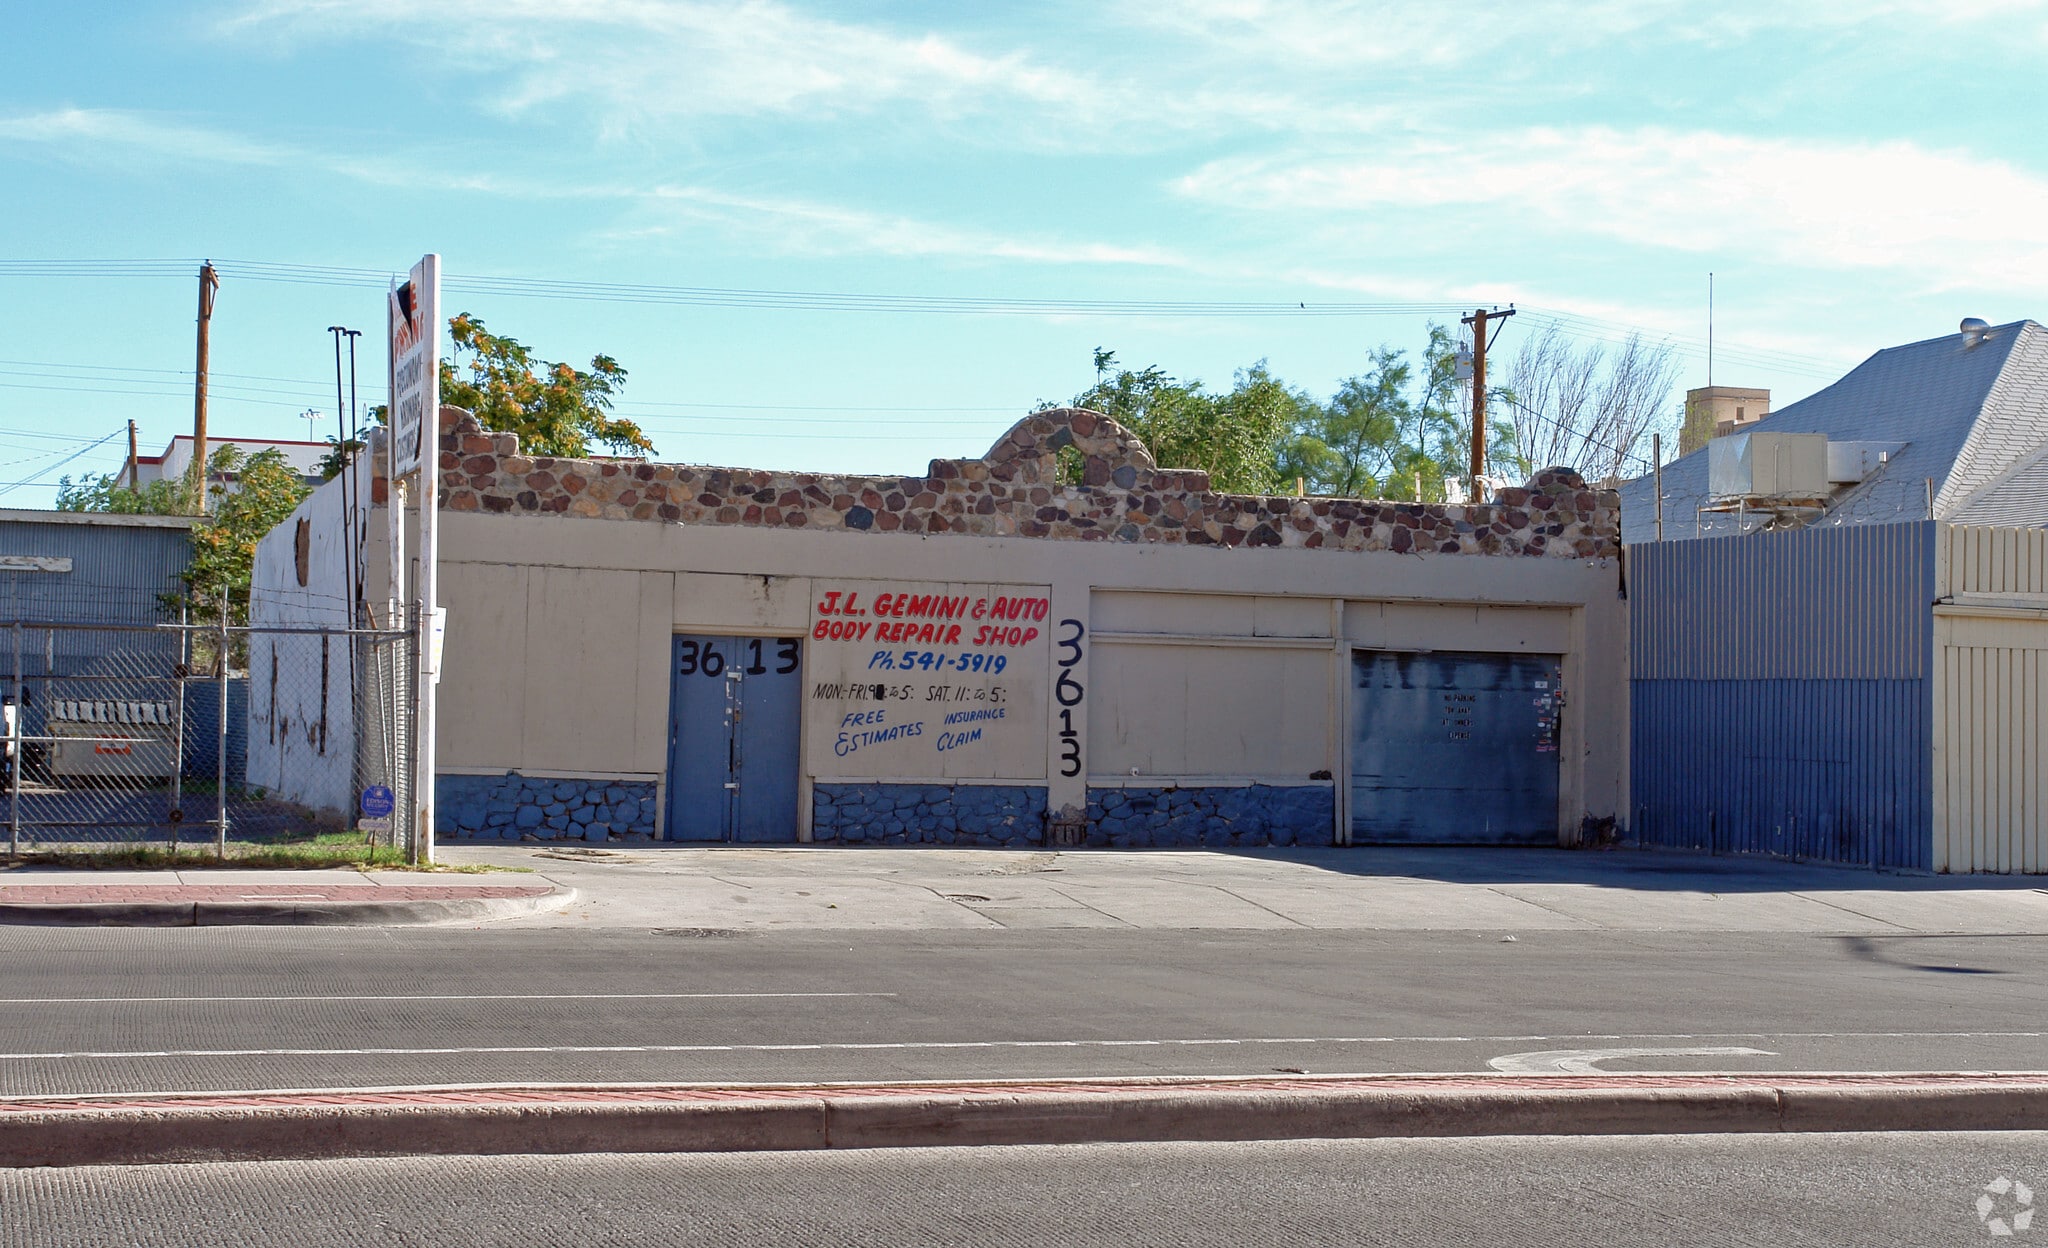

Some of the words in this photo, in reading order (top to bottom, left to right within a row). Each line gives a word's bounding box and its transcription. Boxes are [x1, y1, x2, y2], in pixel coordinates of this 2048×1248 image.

[818, 592, 866, 616] J.L.
[873, 593, 970, 619] GEMINI
[971, 599, 988, 620] &
[989, 597, 1049, 622] AUTO
[813, 619, 872, 642] BODY
[874, 622, 962, 645] REPAIR
[973, 625, 1039, 647] SHOP
[899, 651, 1007, 674] 541-5919
[841, 710, 886, 728] FREE
[944, 708, 1006, 725] INSURANCE
[834, 722, 924, 757] ESTIMATES
[937, 728, 983, 751] CLAIM
